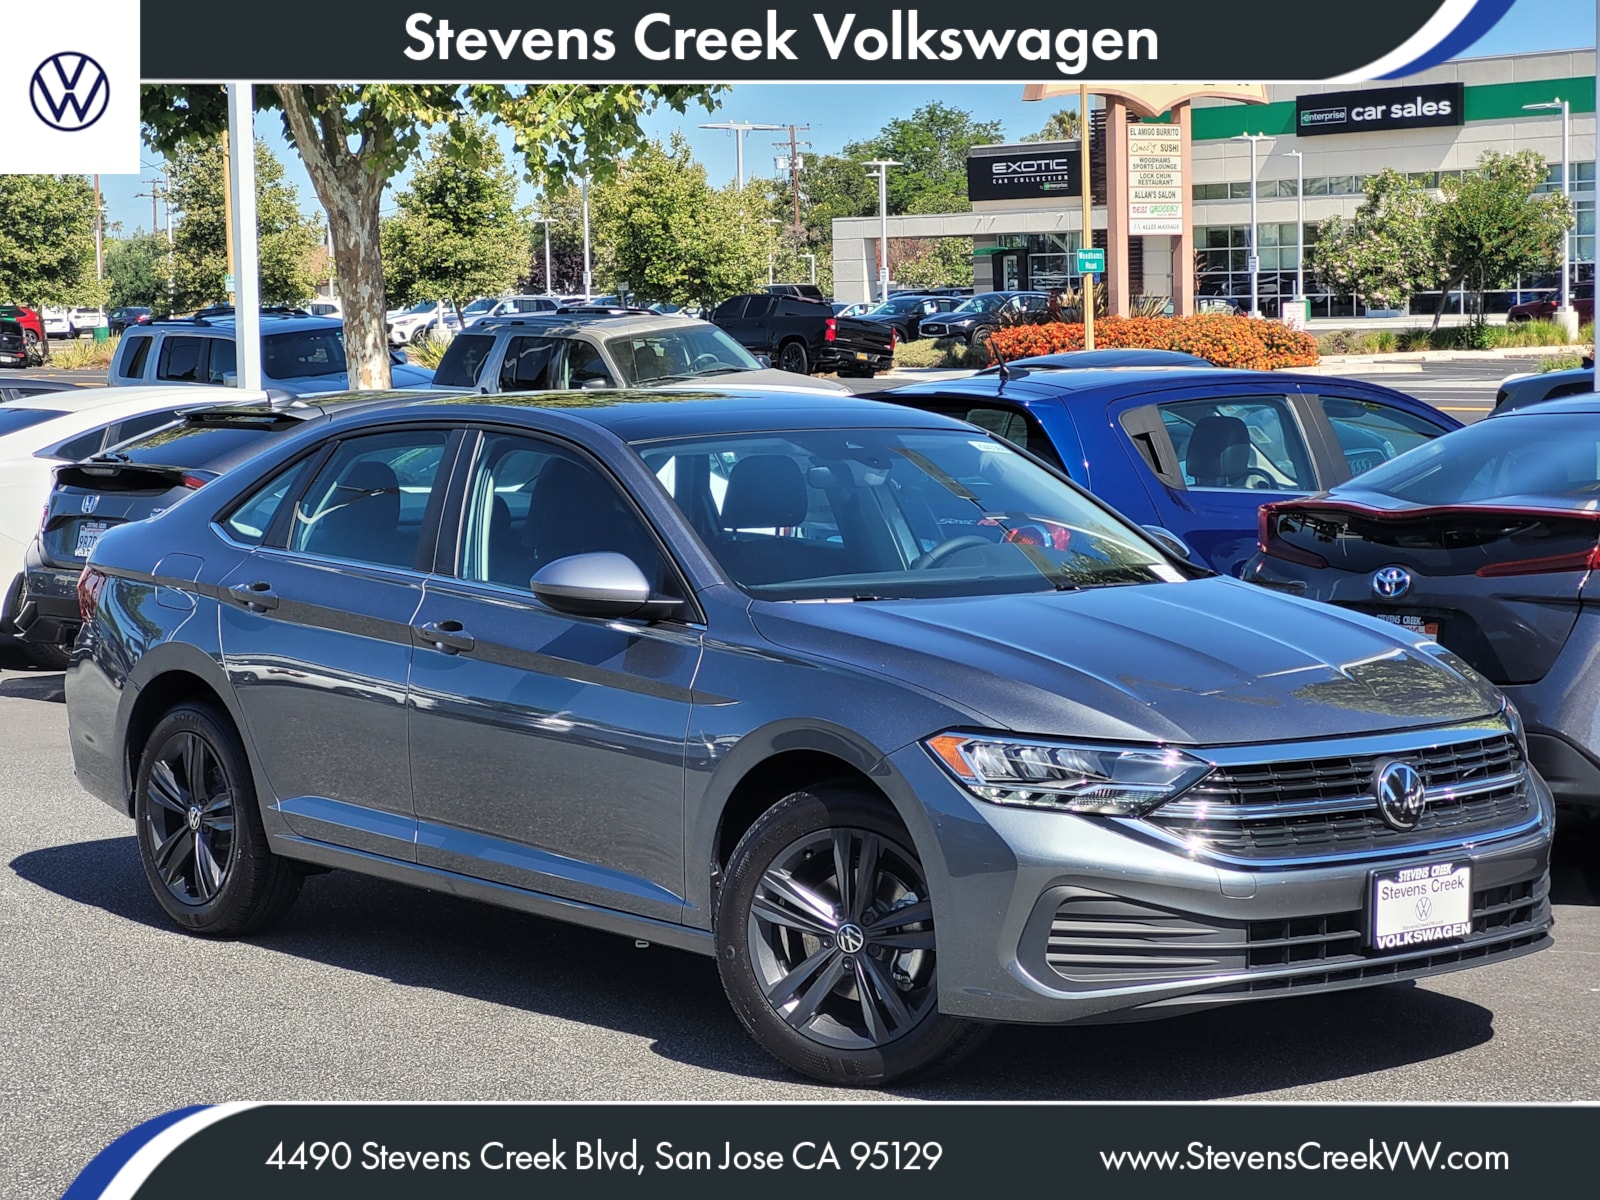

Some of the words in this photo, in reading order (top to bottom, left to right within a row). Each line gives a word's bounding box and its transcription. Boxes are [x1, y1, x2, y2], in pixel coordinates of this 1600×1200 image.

[1301, 111, 1345, 121] enterprise
[1351, 105, 1386, 122] car
[1390, 96, 1452, 119] sales
[1130, 127, 1137, 136] EL
[1138, 127, 1155, 136] AMIGO
[1156, 127, 1179, 137] BURRITO
[1160, 143, 1179, 153] SUSHI
[992, 159, 1068, 173] EXOTIC
[1014, 175, 1069, 183] COLLECTION
[1134, 190, 1157, 199] ALLAN'S
[1157, 190, 1176, 199] SALON
[1402, 615, 1421, 625] CREEK
[1398, 867, 1430, 882] STEVENS
[1431, 863, 1453, 877] CREEK
[1381, 884, 1427, 901] Stevens
[1431, 875, 1465, 893] Creek
[1376, 922, 1472, 949] VOLKSWAGEN
